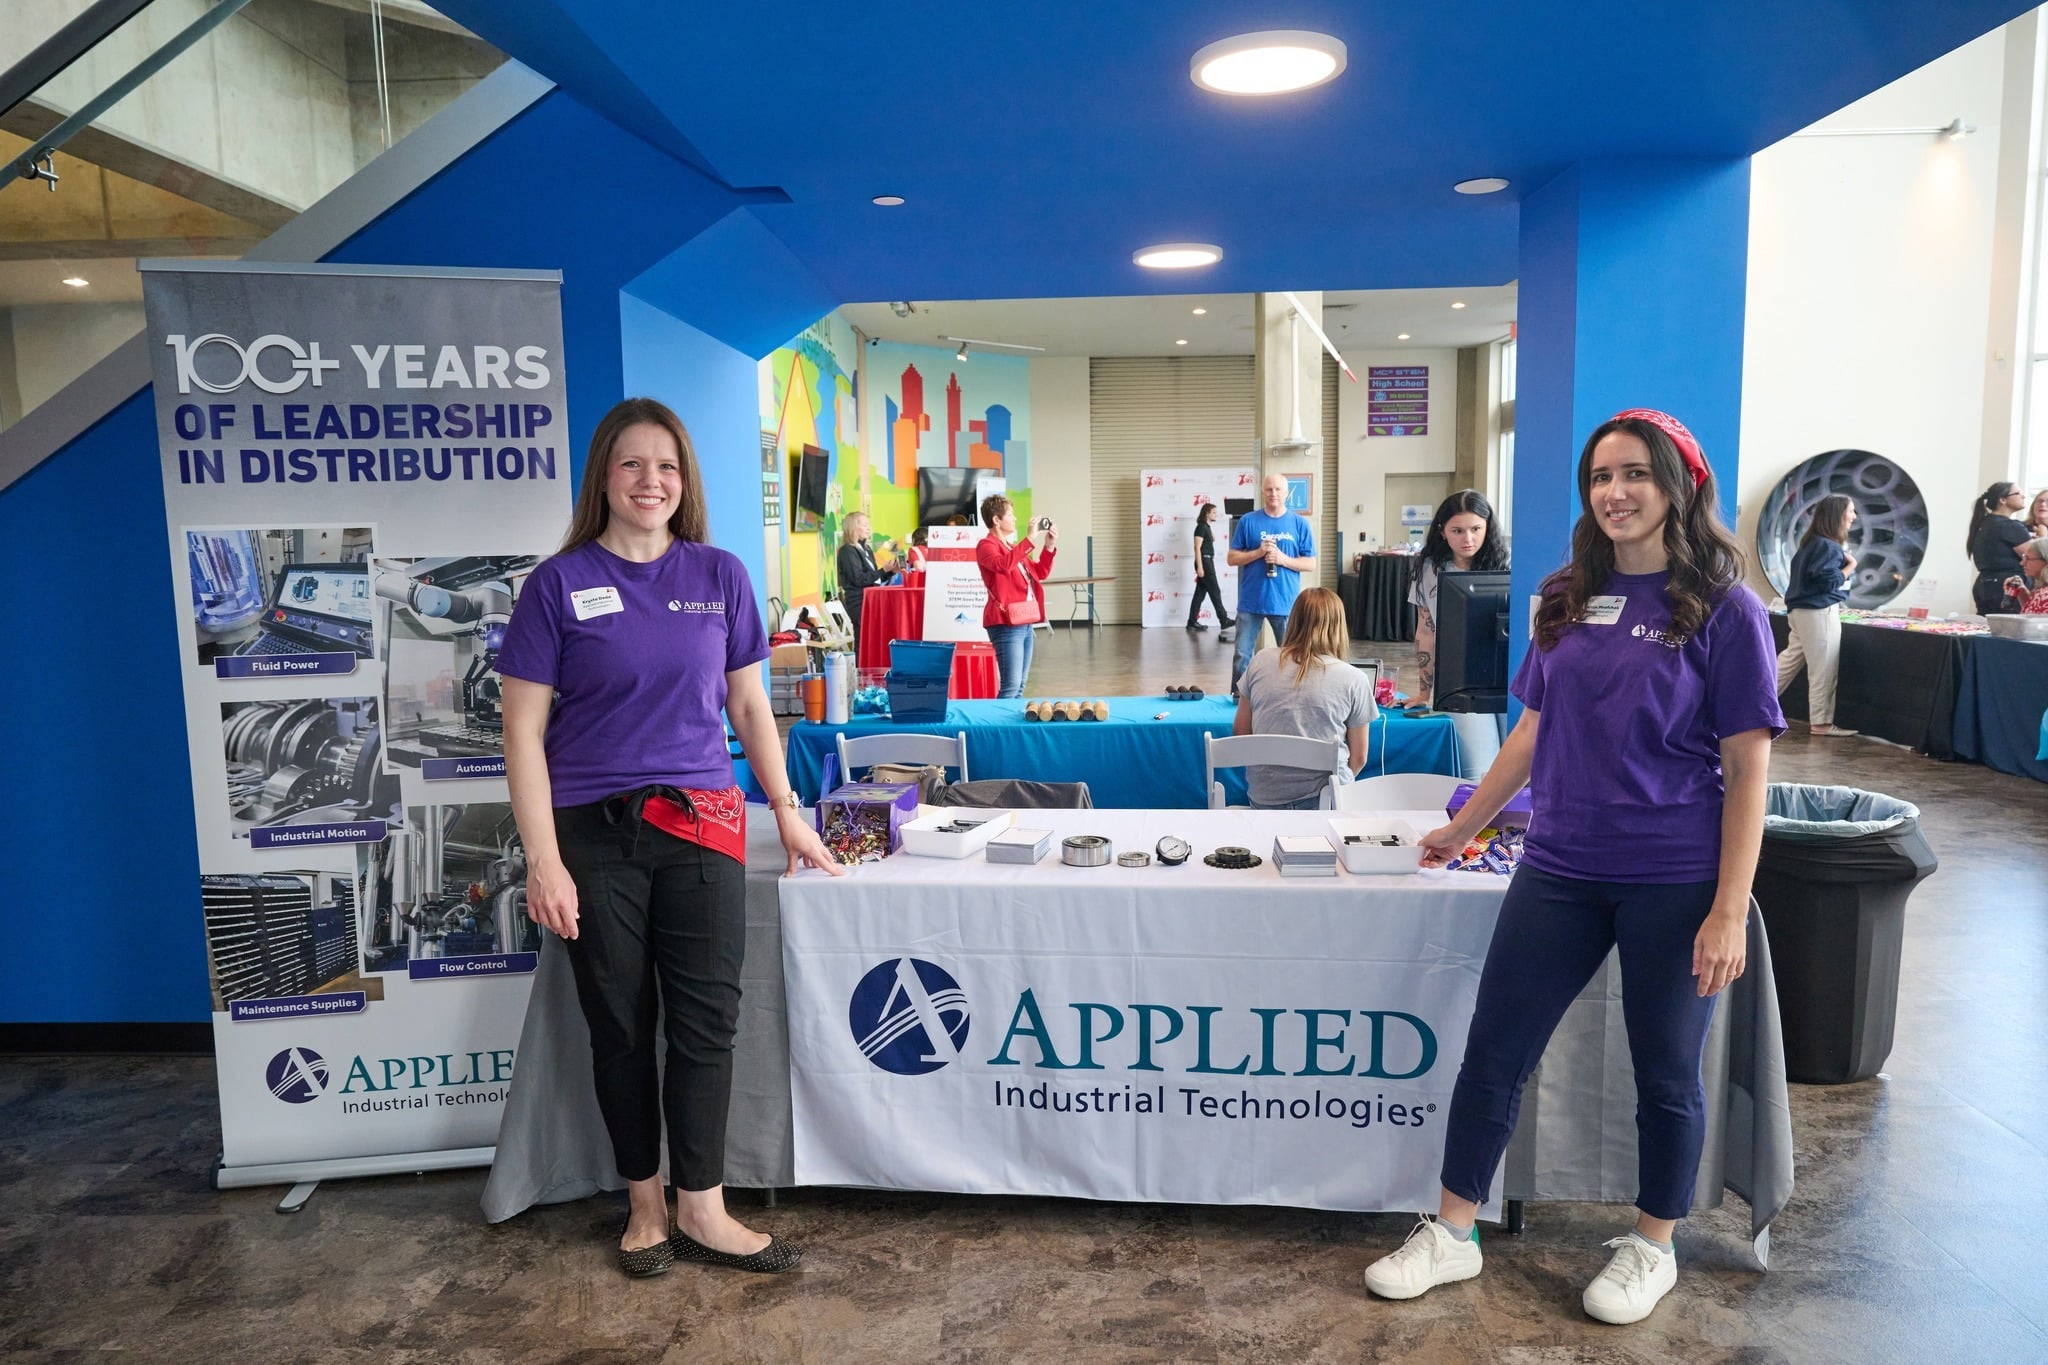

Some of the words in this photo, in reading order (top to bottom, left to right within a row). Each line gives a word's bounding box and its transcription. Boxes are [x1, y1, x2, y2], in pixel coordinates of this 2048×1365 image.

[166, 333, 340, 394] 100+
[351, 344, 551, 390] YEARS
[1372, 380, 1392, 388] High
[1394, 379, 1424, 387] School
[174, 404, 236, 441] OF
[252, 403, 553, 440] LEADERSHIP
[178, 449, 225, 485] IN
[240, 447, 557, 484] DISTRIBUTION
[683, 601, 725, 610] APPLIED
[252, 660, 280, 672] Fluid
[283, 658, 320, 671] Power
[456, 763, 507, 773] Automati
[270, 828, 324, 842] Industrial
[327, 826, 367, 840] Motion
[439, 961, 462, 973] Flow
[464, 959, 508, 972] Control
[238, 1001, 309, 1016] Maintenance
[311, 997, 357, 1013] Supplies
[986, 987, 1438, 1081] APPLIED
[338, 1049, 514, 1095] APPLIE
[343, 1094, 429, 1114] Industrial
[994, 1080, 1165, 1114] Industrial
